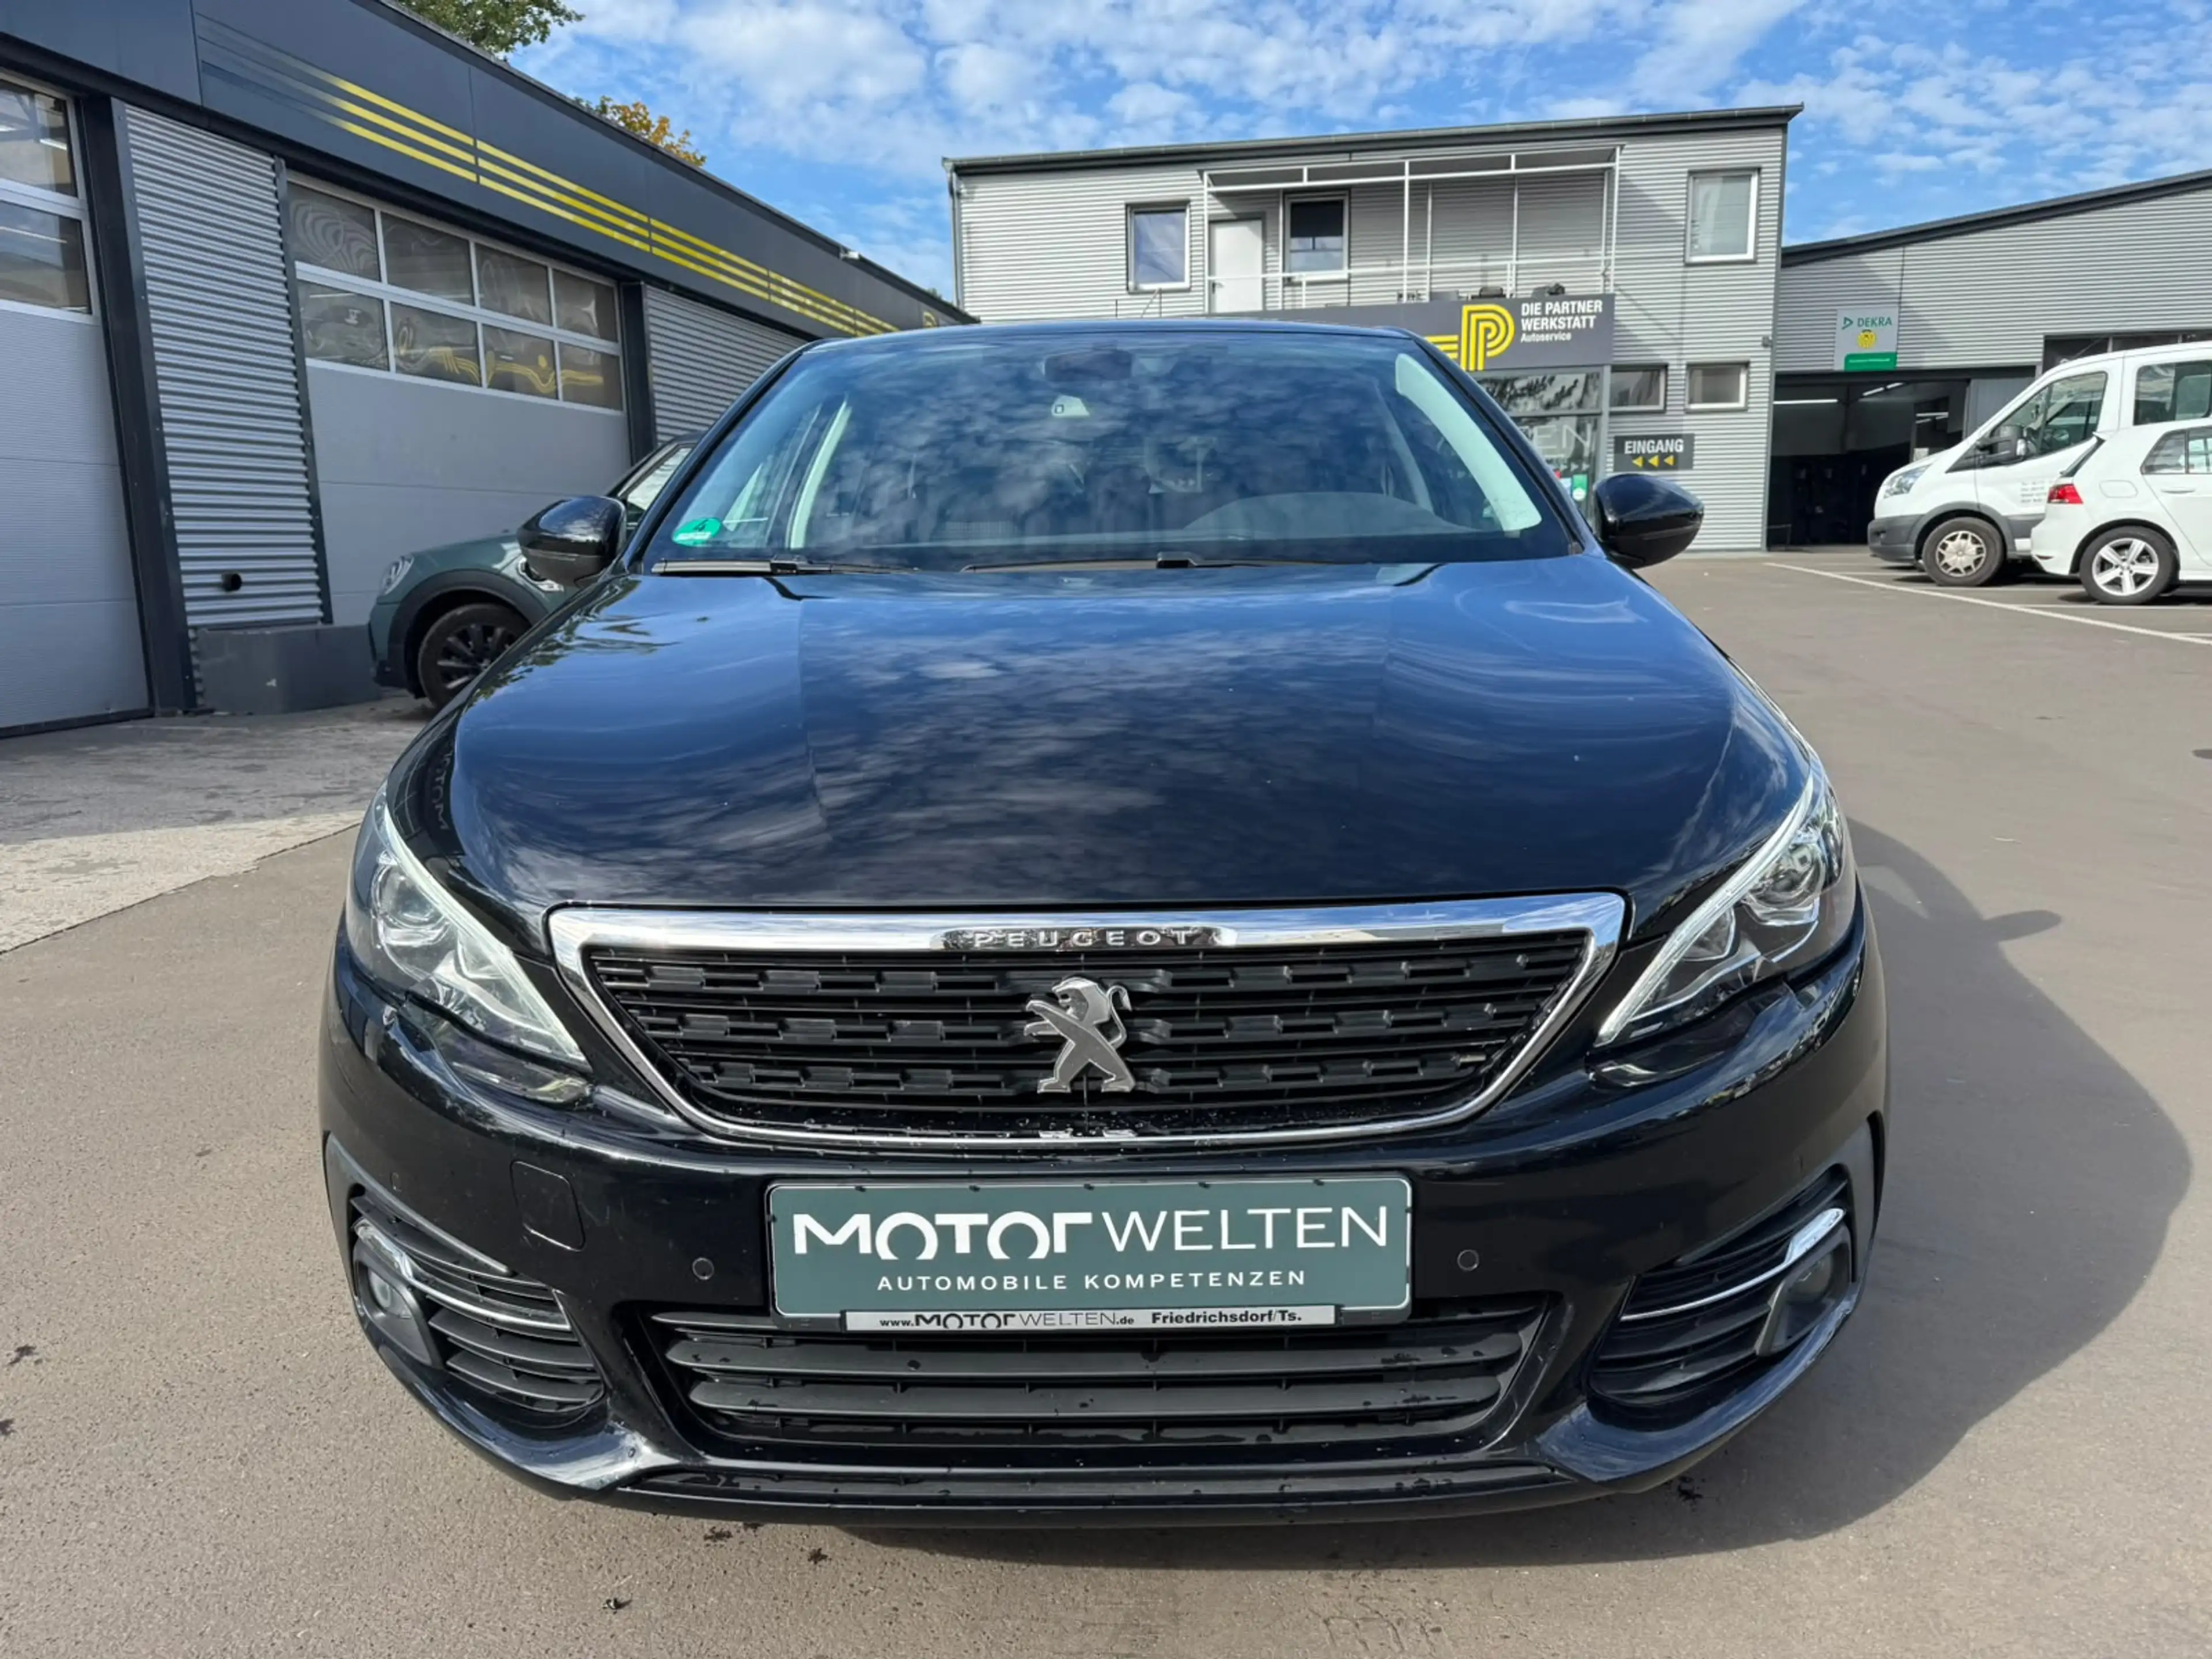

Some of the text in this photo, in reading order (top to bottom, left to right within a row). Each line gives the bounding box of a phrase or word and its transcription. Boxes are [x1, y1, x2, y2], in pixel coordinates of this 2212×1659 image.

[1521, 300, 1603, 316] DIE PARTNER
[1521, 315, 1596, 331] WERKSTATT
[1857, 316, 1892, 328] DEKRA
[1521, 331, 1571, 343] Autoservice
[1624, 439, 1684, 454] EINGANG
[974, 930, 1189, 948] PEUGEOT
[877, 1270, 1305, 1291] AUTOMOBILE KOMPETENZEN
[1152, 1309, 1302, 1324] Friedrichsdorf/Ts.
